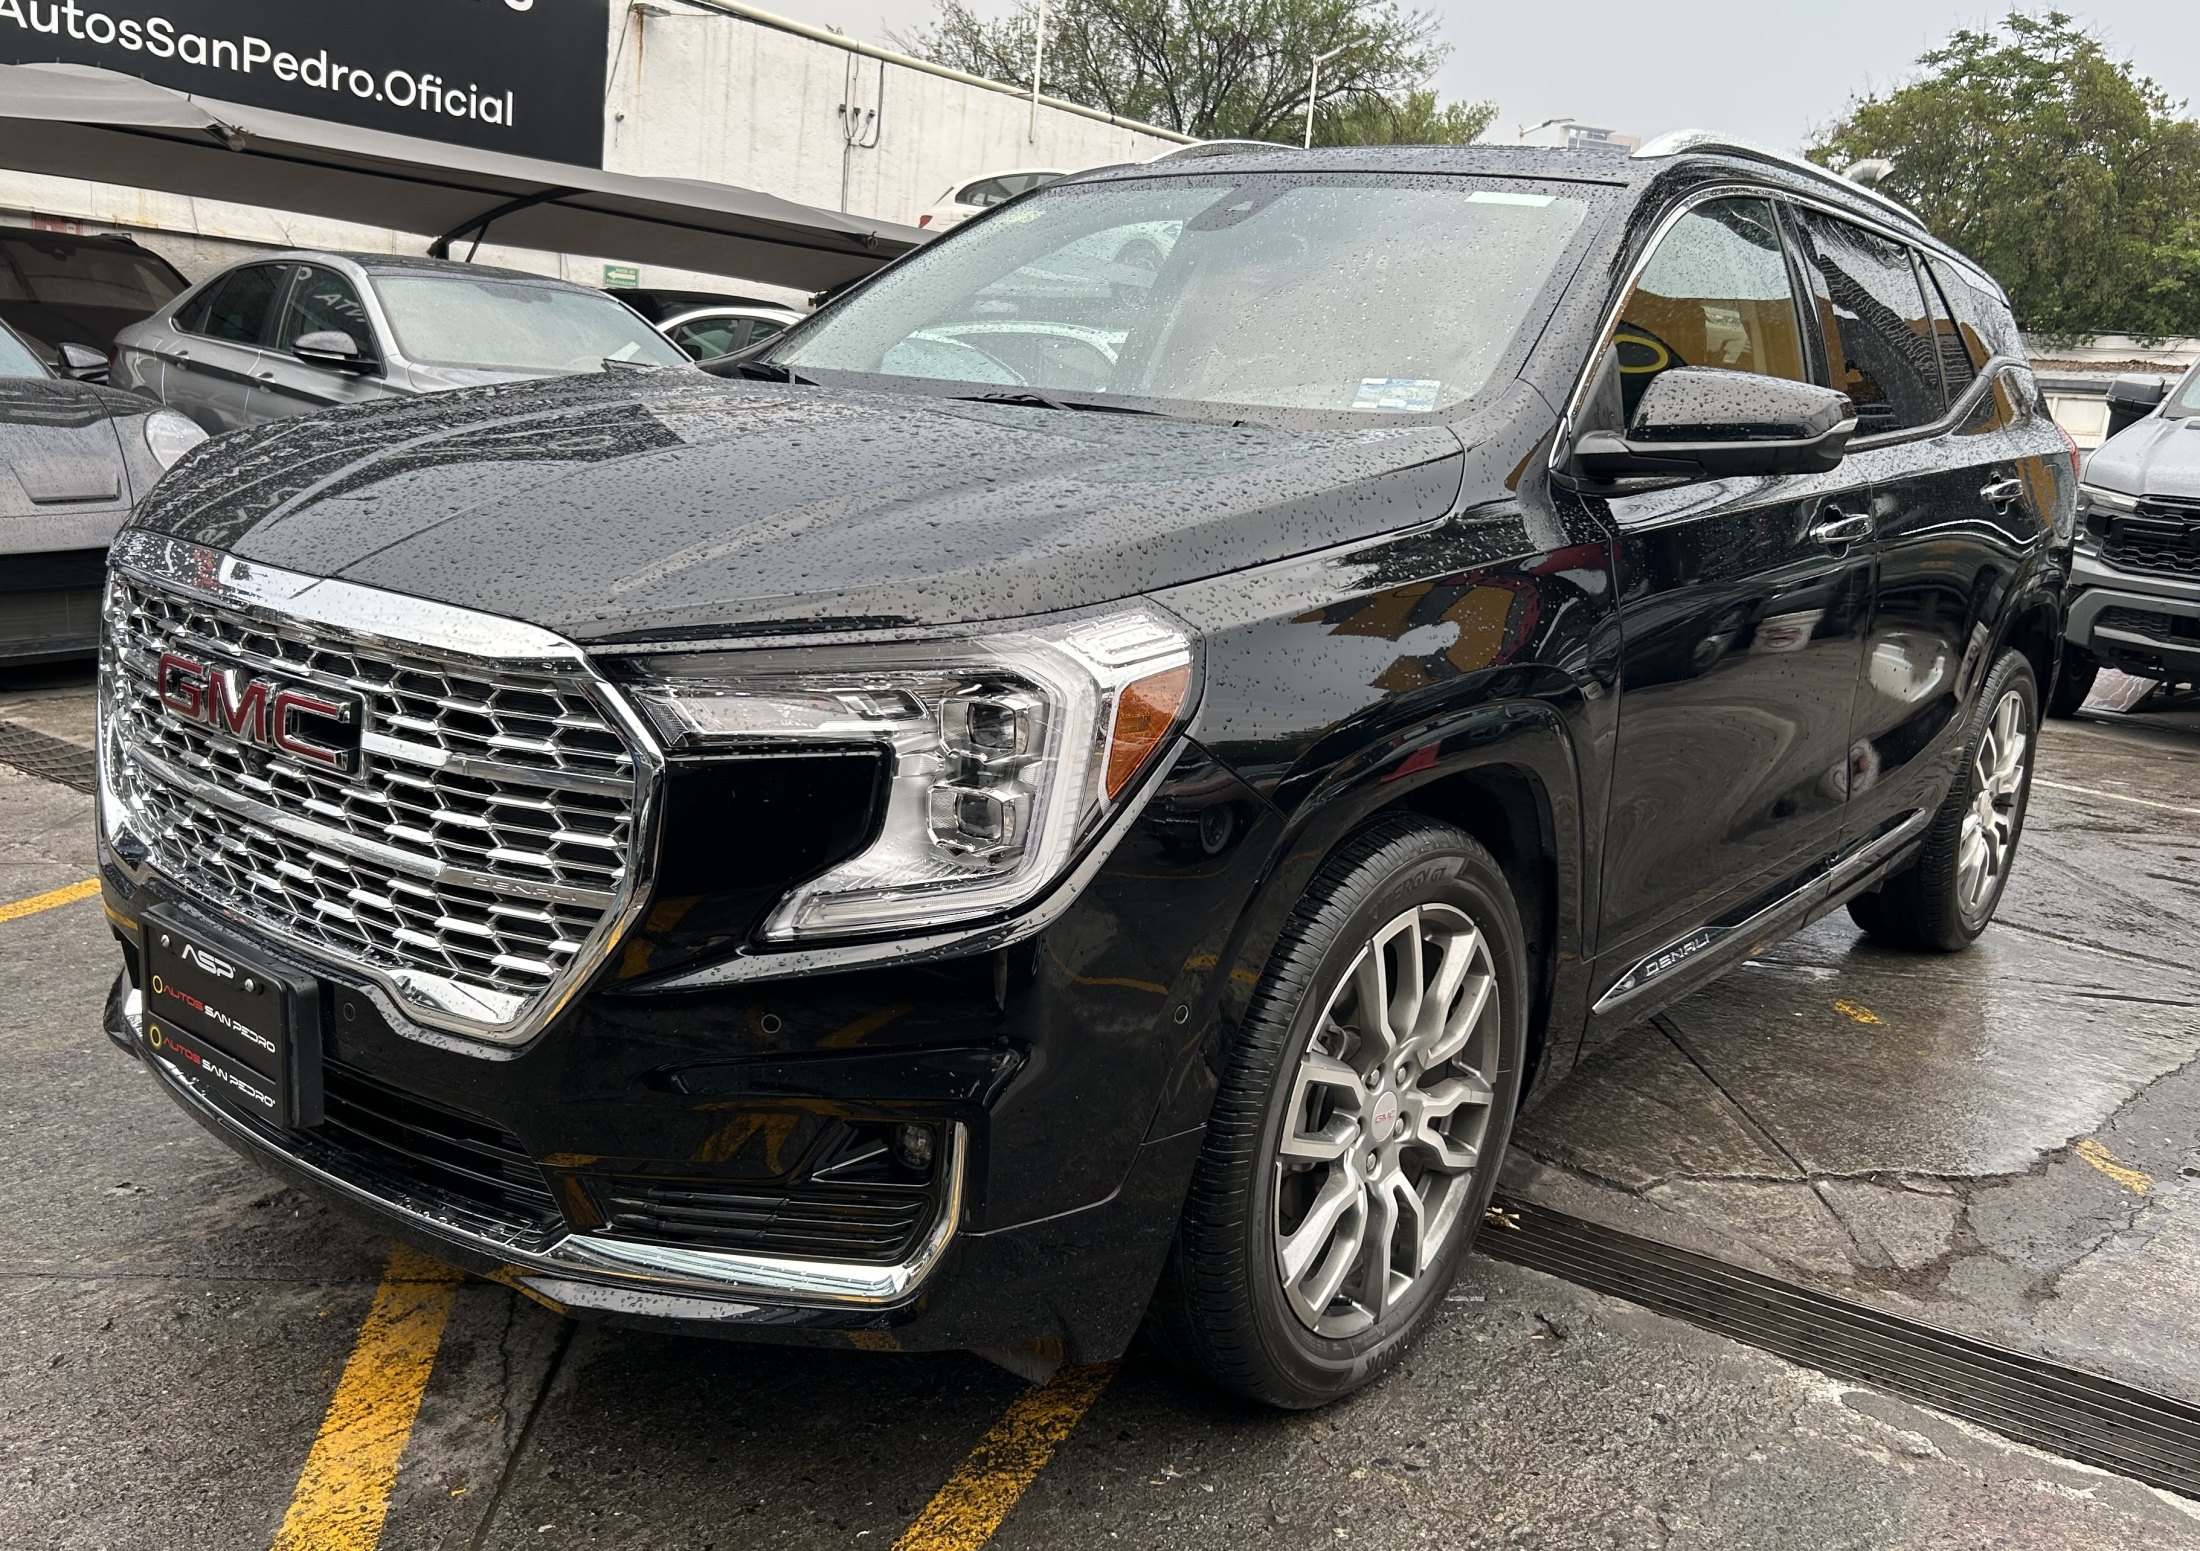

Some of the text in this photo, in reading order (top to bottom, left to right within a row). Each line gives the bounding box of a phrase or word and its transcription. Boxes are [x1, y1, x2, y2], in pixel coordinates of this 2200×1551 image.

[0, 0, 514, 127] AutosSanPedro.Oficial
[158, 652, 349, 771] GMC
[181, 943, 235, 979] ASP
[1645, 933, 1710, 977] DENALI
[163, 984, 276, 1054] AUTOS SAN PEDRO
[163, 1036, 275, 1108] AUTOS SAN PEDRO
